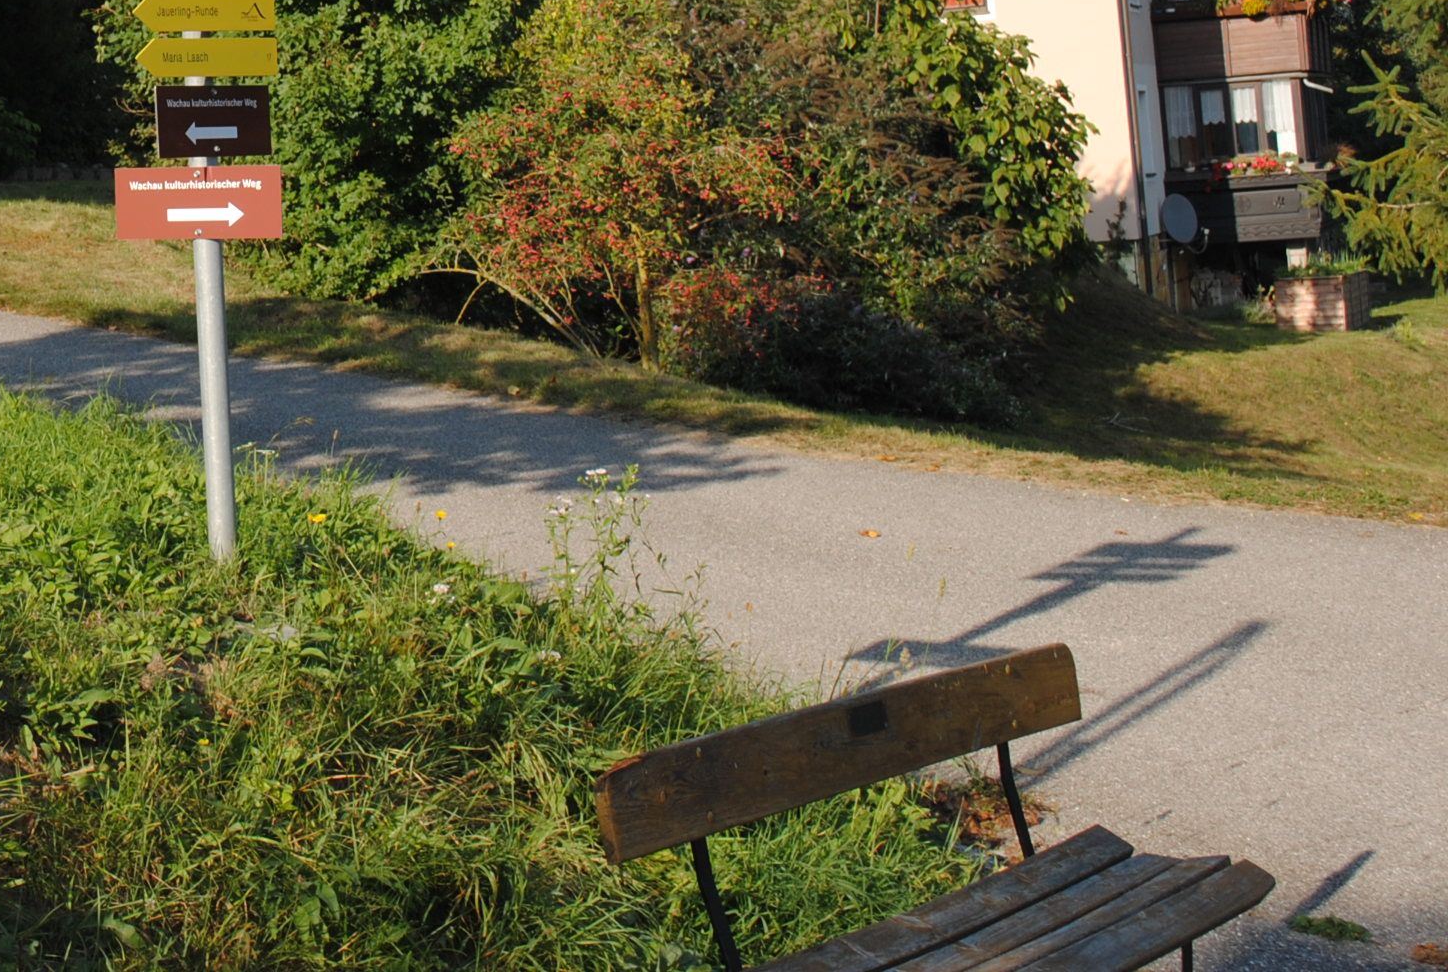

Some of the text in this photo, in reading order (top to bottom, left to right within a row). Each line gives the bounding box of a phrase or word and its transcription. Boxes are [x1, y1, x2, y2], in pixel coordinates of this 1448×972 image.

[157, 6, 218, 19] Jauerling-Runde
[162, 52, 182, 63] Maria
[187, 52, 209, 62] Laach
[166, 98, 257, 109] Wachau kulturhistorischer Weg
[129, 179, 261, 191] Wachau kulturhistorischer Weg
